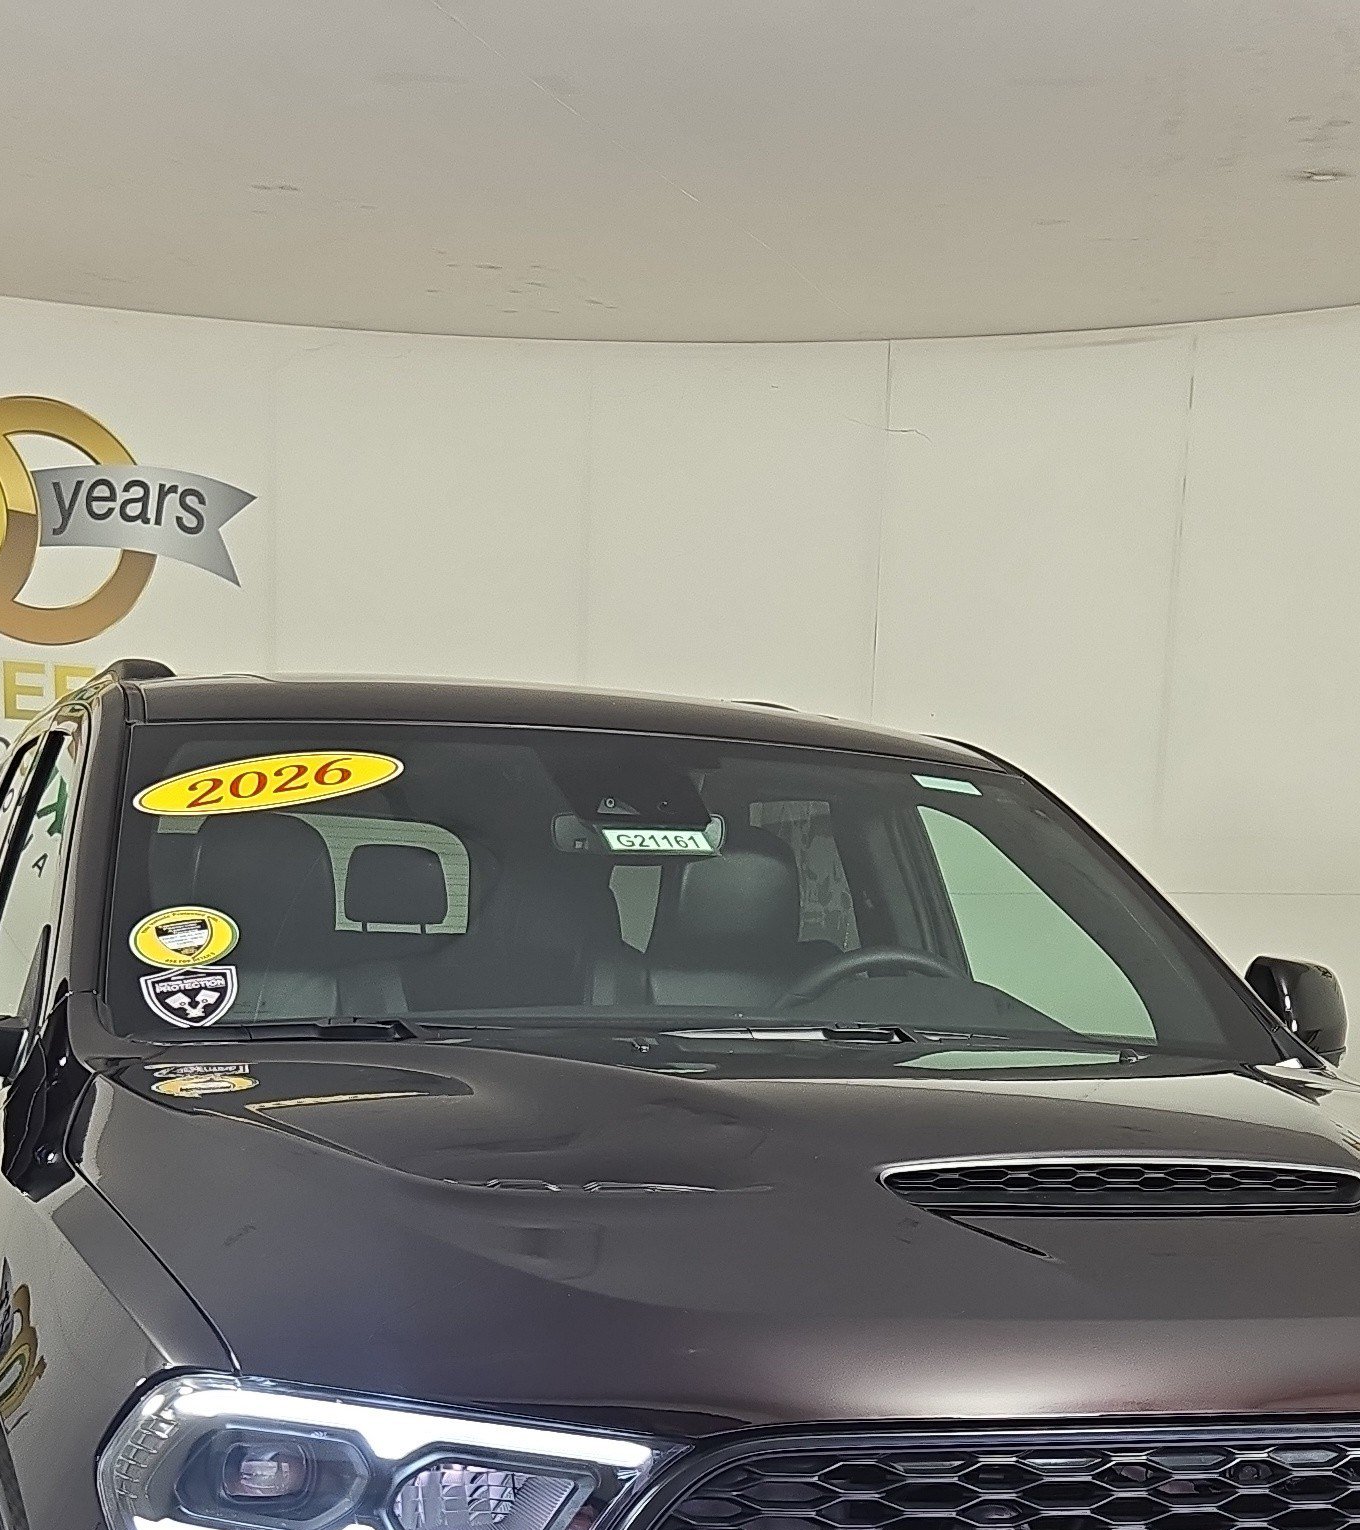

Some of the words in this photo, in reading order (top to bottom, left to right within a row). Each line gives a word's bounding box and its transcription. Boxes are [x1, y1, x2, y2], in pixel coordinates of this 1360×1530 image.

[51, 477, 206, 536] years
[187, 758, 352, 809] 2026
[616, 834, 701, 848] G21161
[155, 978, 226, 993] PROTECTION
